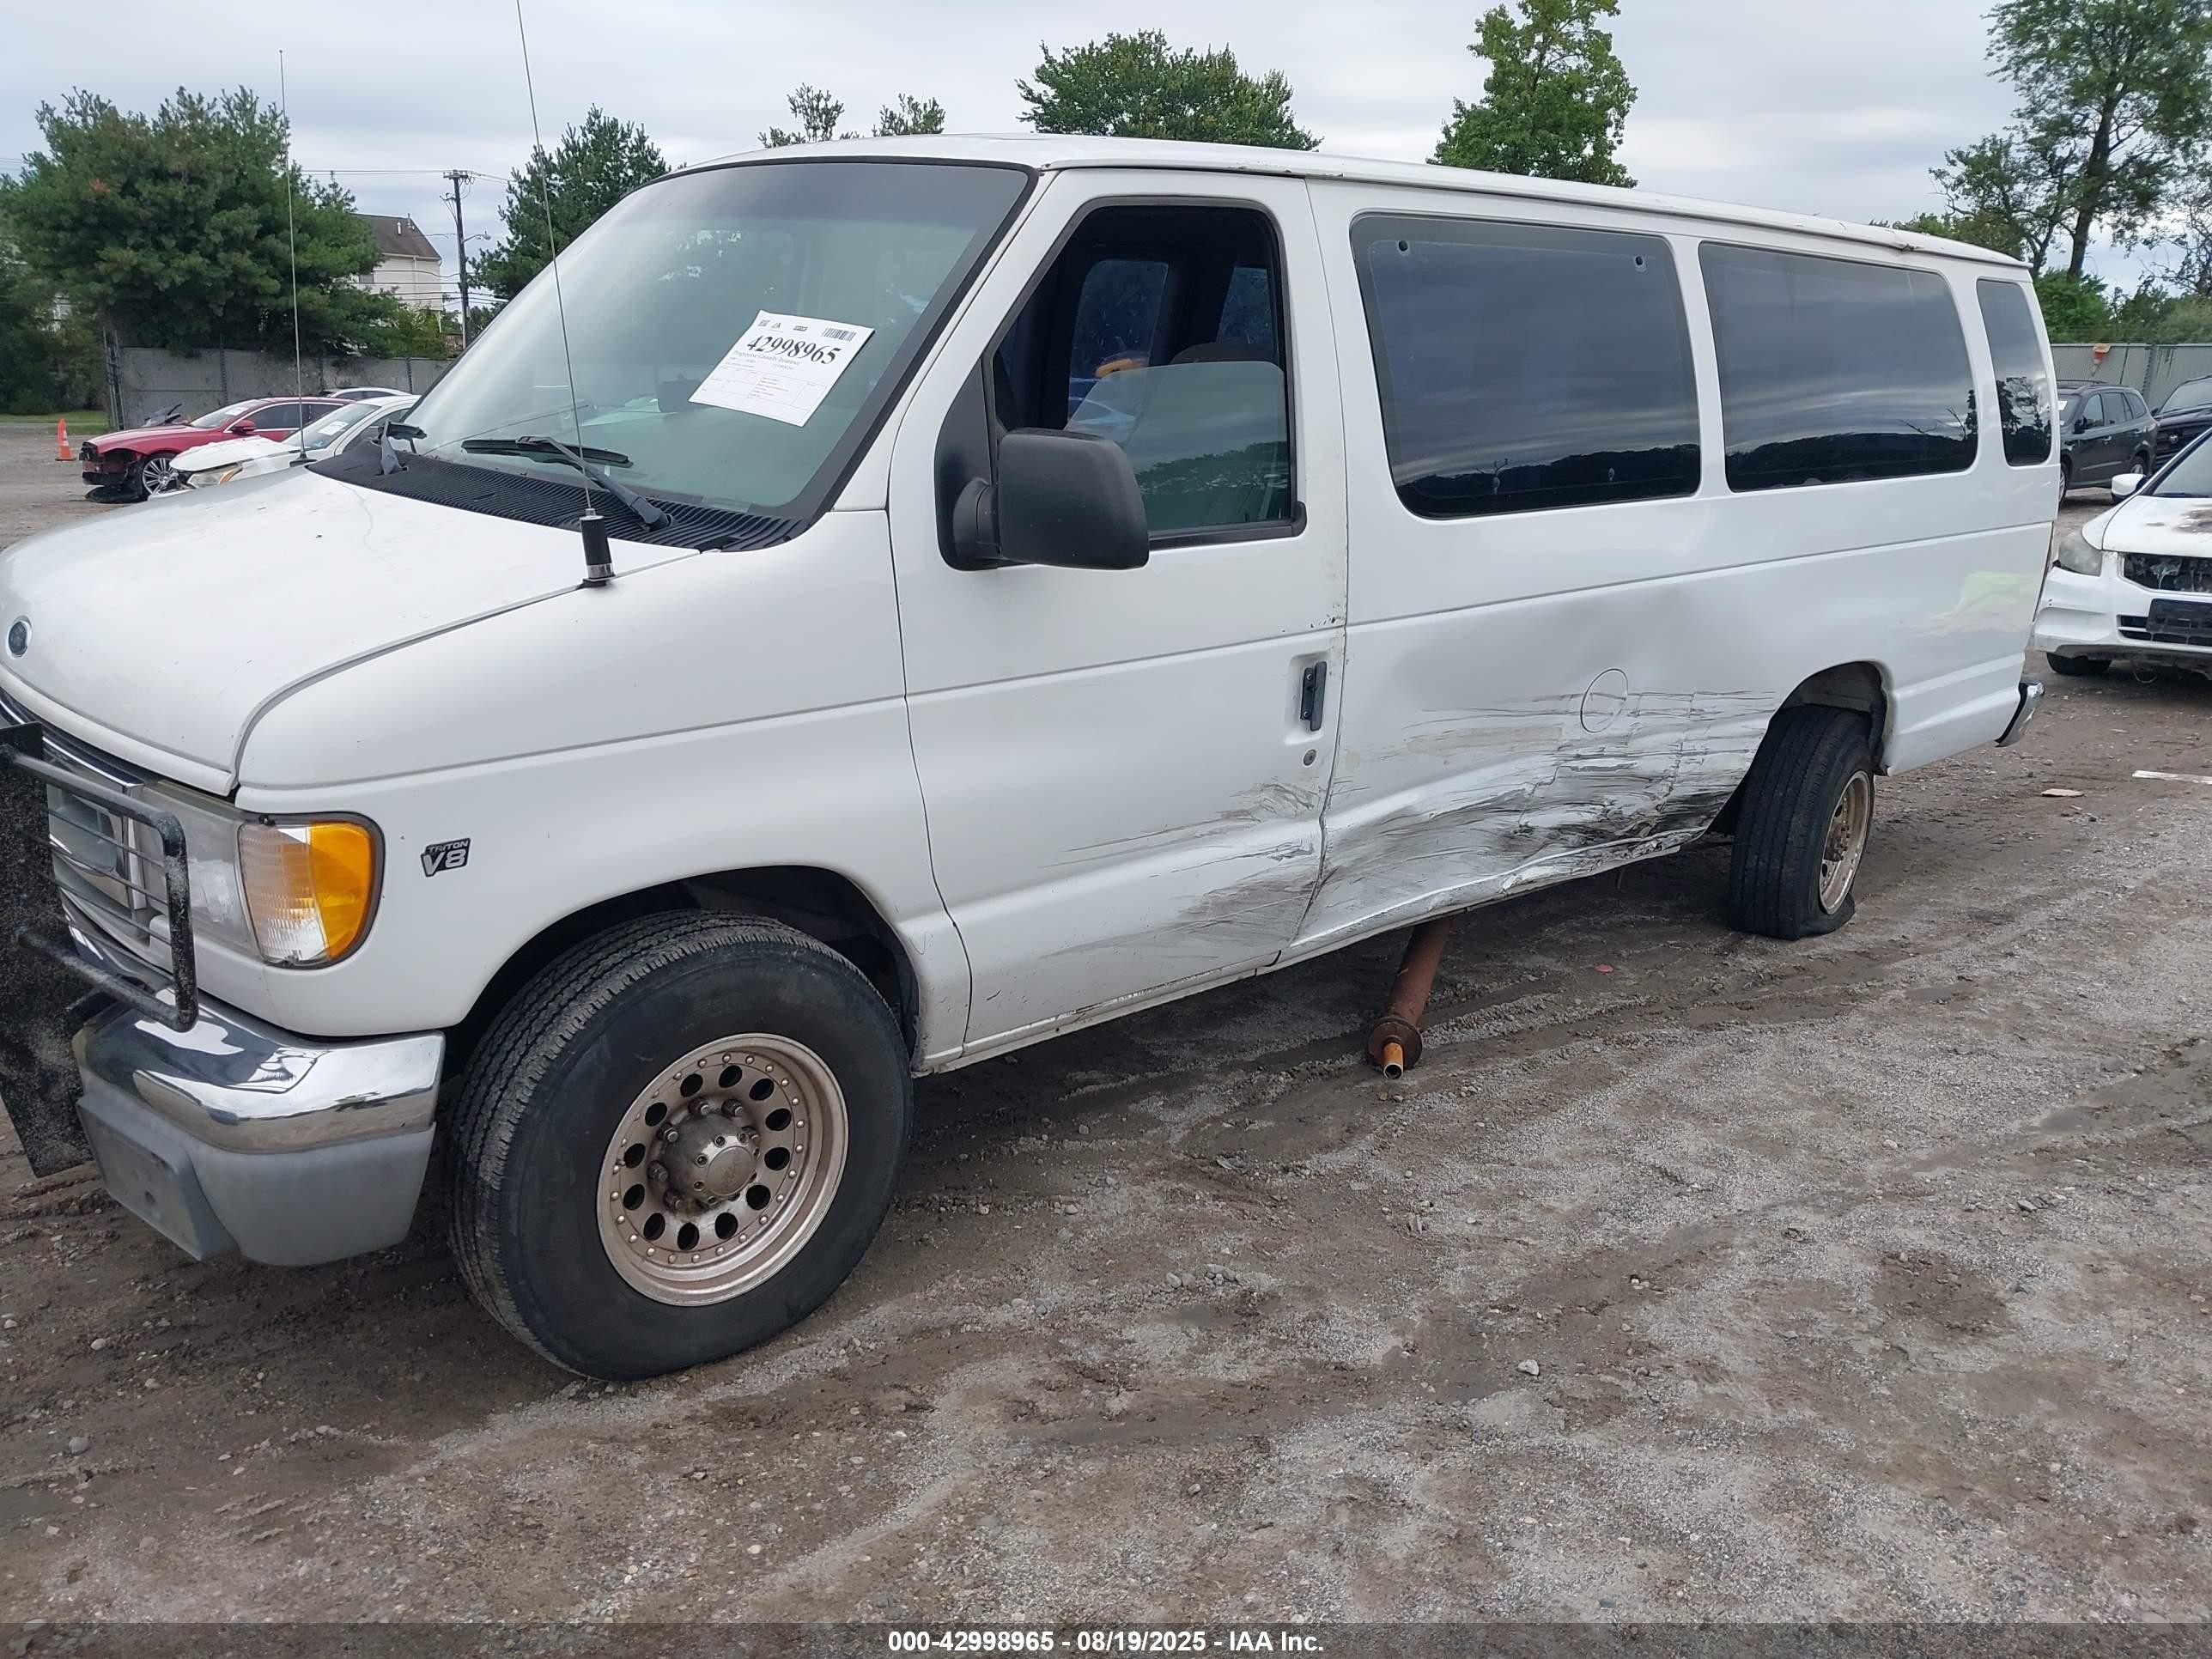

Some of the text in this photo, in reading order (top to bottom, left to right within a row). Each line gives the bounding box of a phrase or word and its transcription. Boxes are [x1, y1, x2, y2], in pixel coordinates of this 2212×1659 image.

[747, 335, 842, 364] 42998965
[427, 841, 469, 853] TRITON
[422, 848, 466, 875] V8
